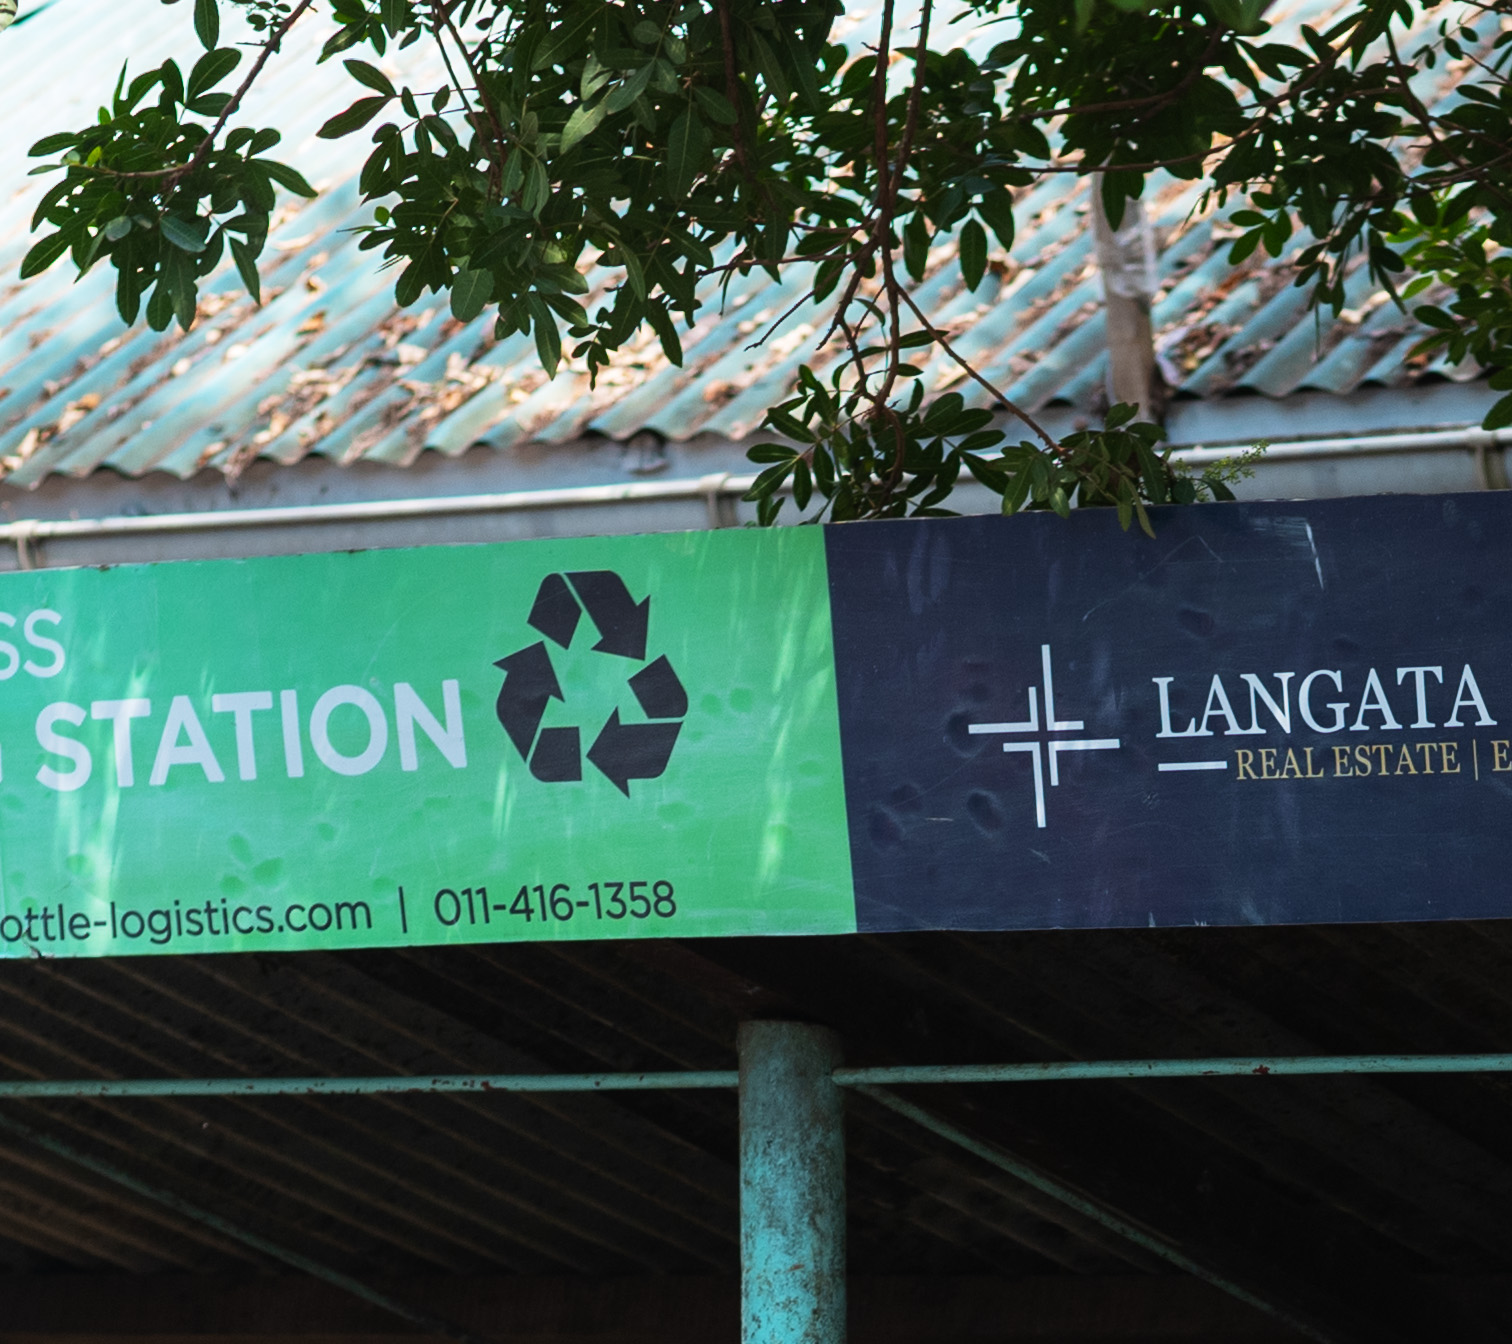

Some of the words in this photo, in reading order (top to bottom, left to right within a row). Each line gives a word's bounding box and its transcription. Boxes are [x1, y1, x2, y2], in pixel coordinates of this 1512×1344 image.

[1152, 664, 1497, 737] LANGATA
[36, 679, 467, 793] STATION
[1235, 747, 1323, 779] REAL
[1332, 742, 1460, 776] ESTATE
[434, 880, 676, 925] 011-416-1358
